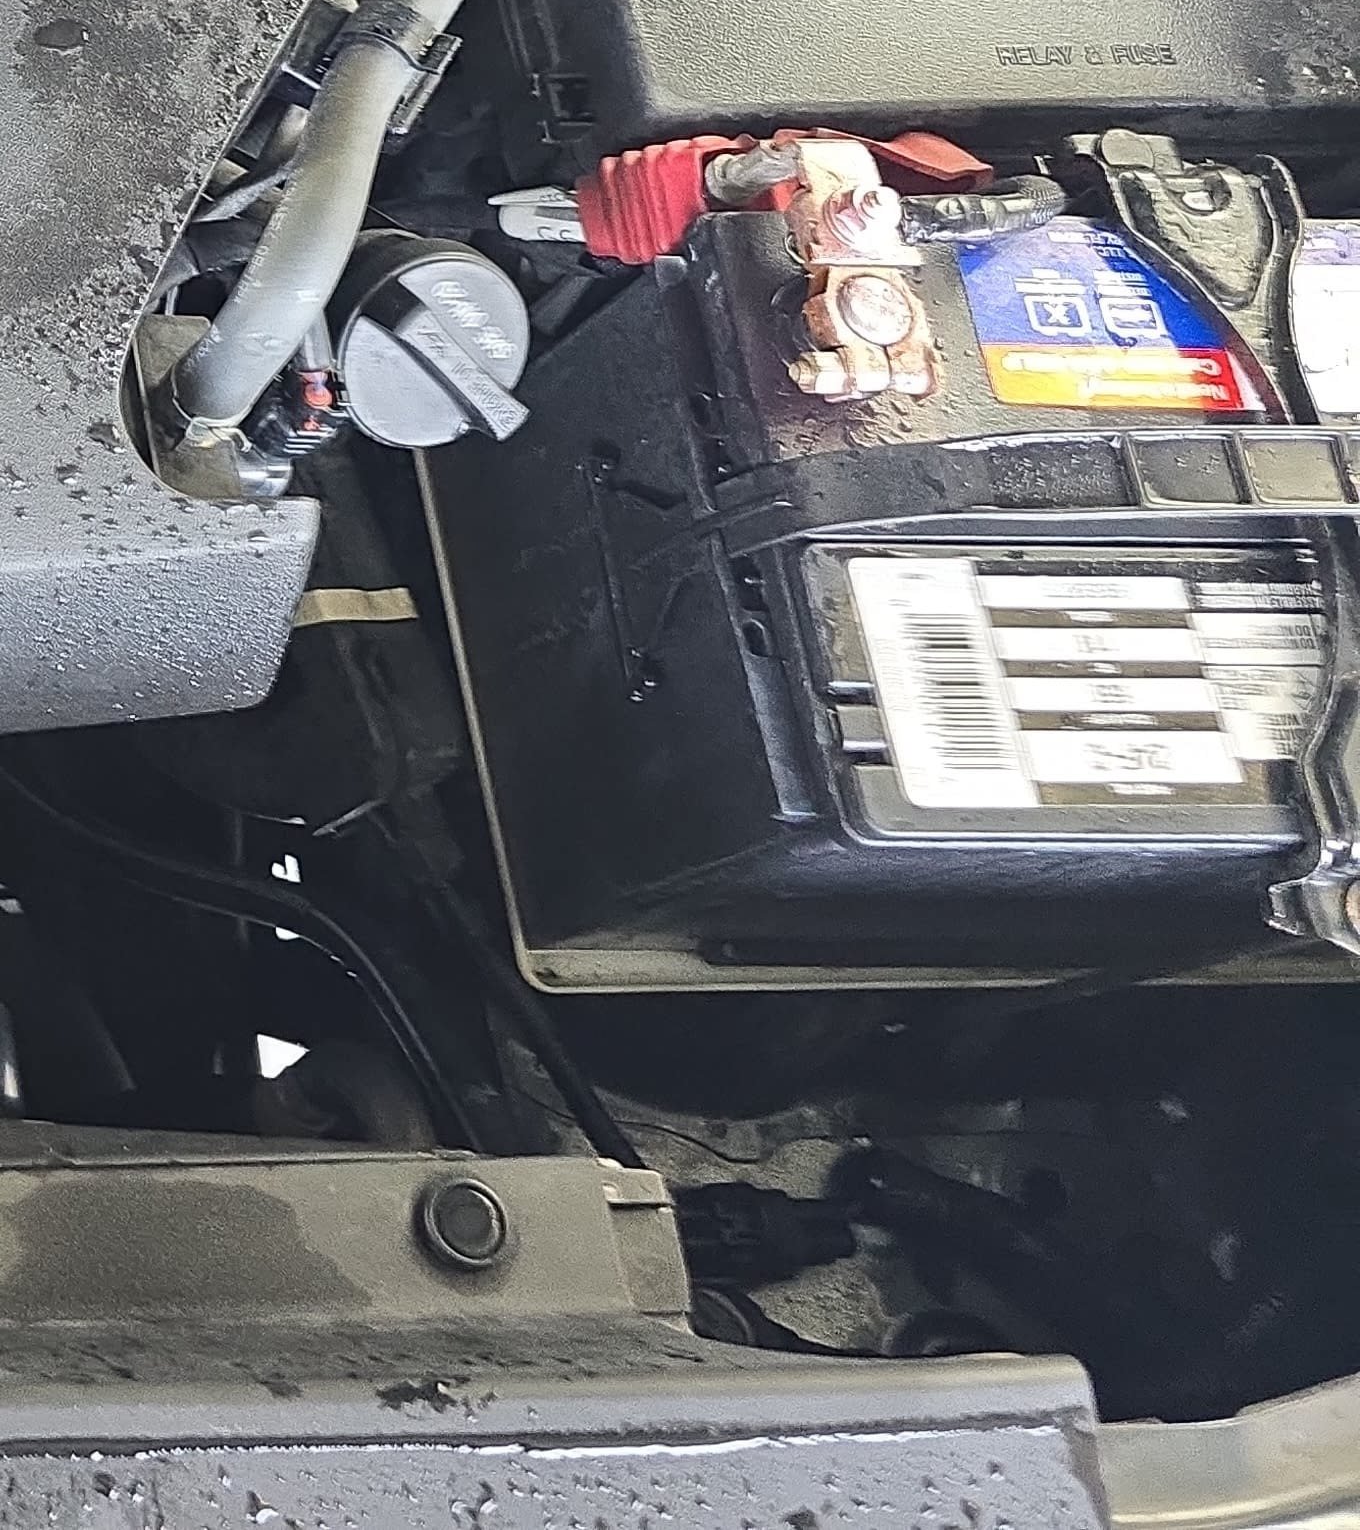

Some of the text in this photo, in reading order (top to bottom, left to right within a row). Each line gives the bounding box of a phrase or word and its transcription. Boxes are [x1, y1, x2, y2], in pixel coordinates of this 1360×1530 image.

[995, 42, 1177, 66] RELAY & FUSE
